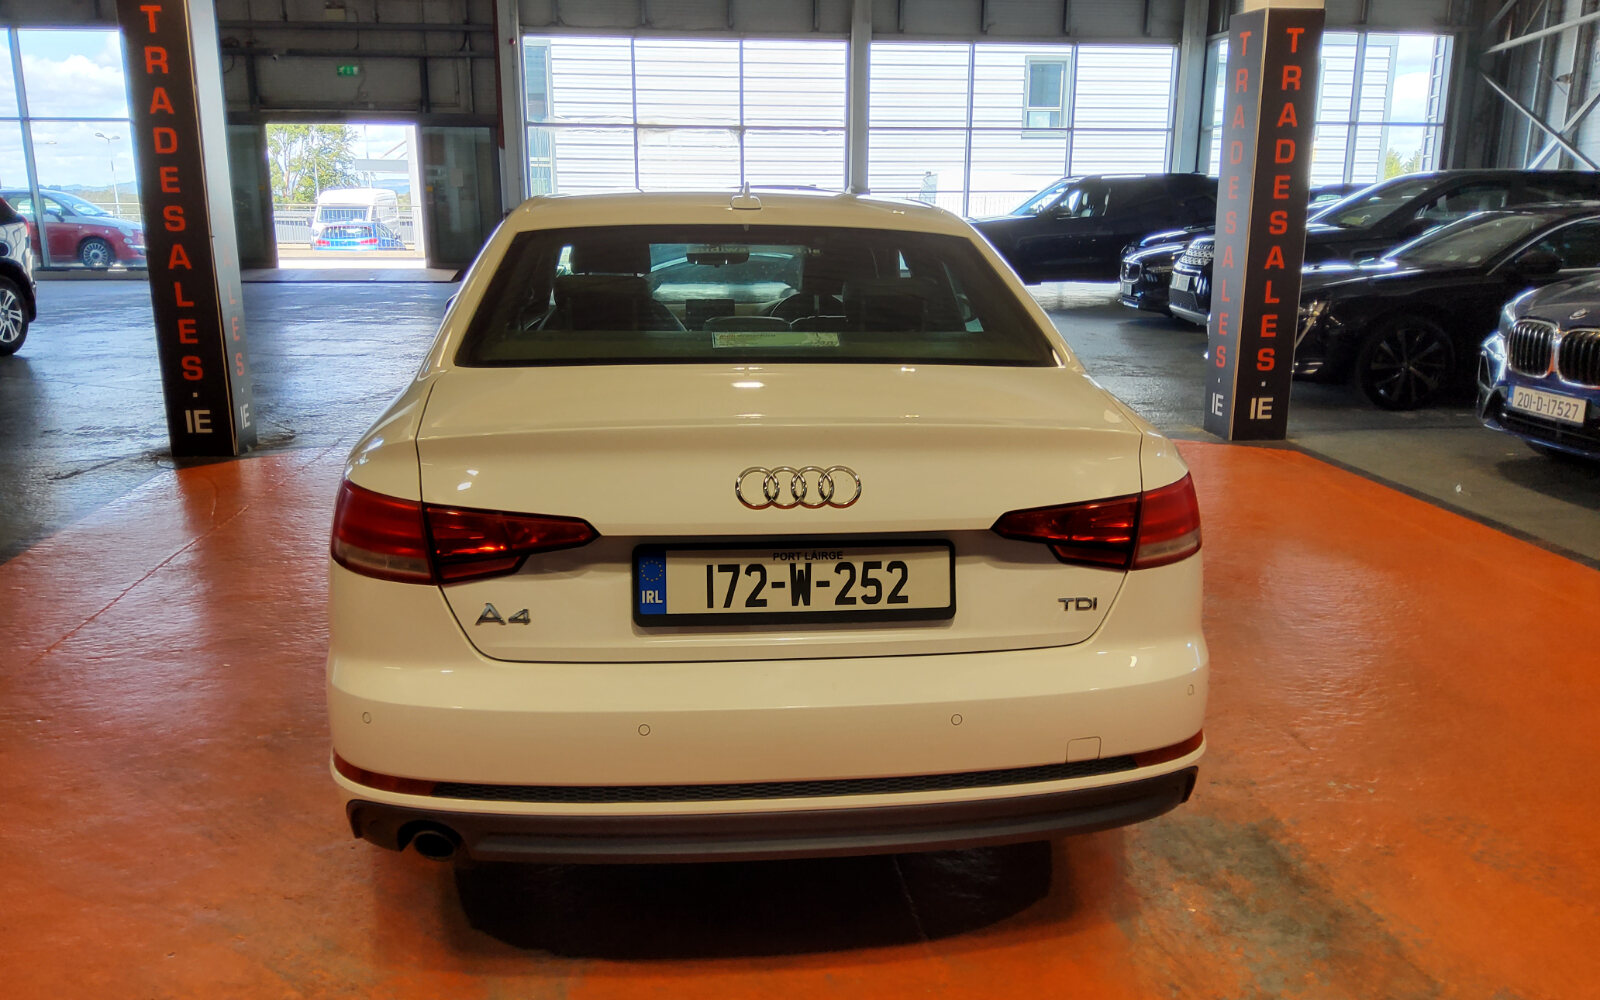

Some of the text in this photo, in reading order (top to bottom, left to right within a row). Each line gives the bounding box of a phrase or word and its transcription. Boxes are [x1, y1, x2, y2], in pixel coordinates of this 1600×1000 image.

[1516, 390, 1579, 420] 201-D-17527
[772, 550, 844, 561] PORT LÁIRGE
[705, 560, 909, 609] 172-W-252
[641, 590, 664, 604] IRL
[1057, 596, 1098, 612] TDI
[475, 602, 531, 626] A4
